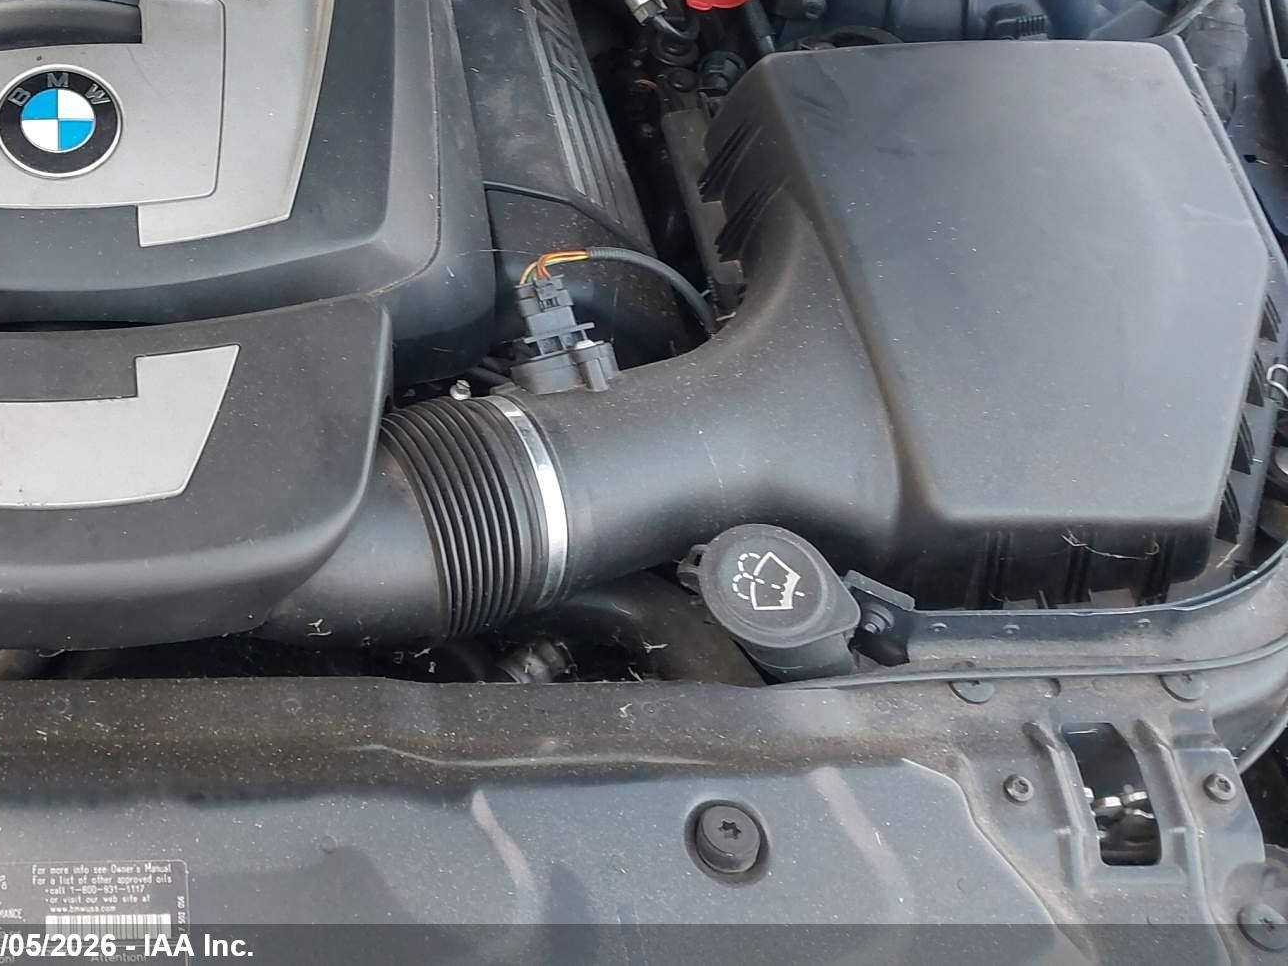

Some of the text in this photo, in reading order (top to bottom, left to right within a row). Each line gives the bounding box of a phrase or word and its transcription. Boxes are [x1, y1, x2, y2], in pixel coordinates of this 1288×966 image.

[7, 71, 111, 107] BMW
[32, 864, 46, 875] For
[50, 867, 69, 875] more
[73, 864, 90, 874] info
[144, 862, 172, 873] Manual
[91, 874, 112, 884] other
[117, 874, 152, 885] approved
